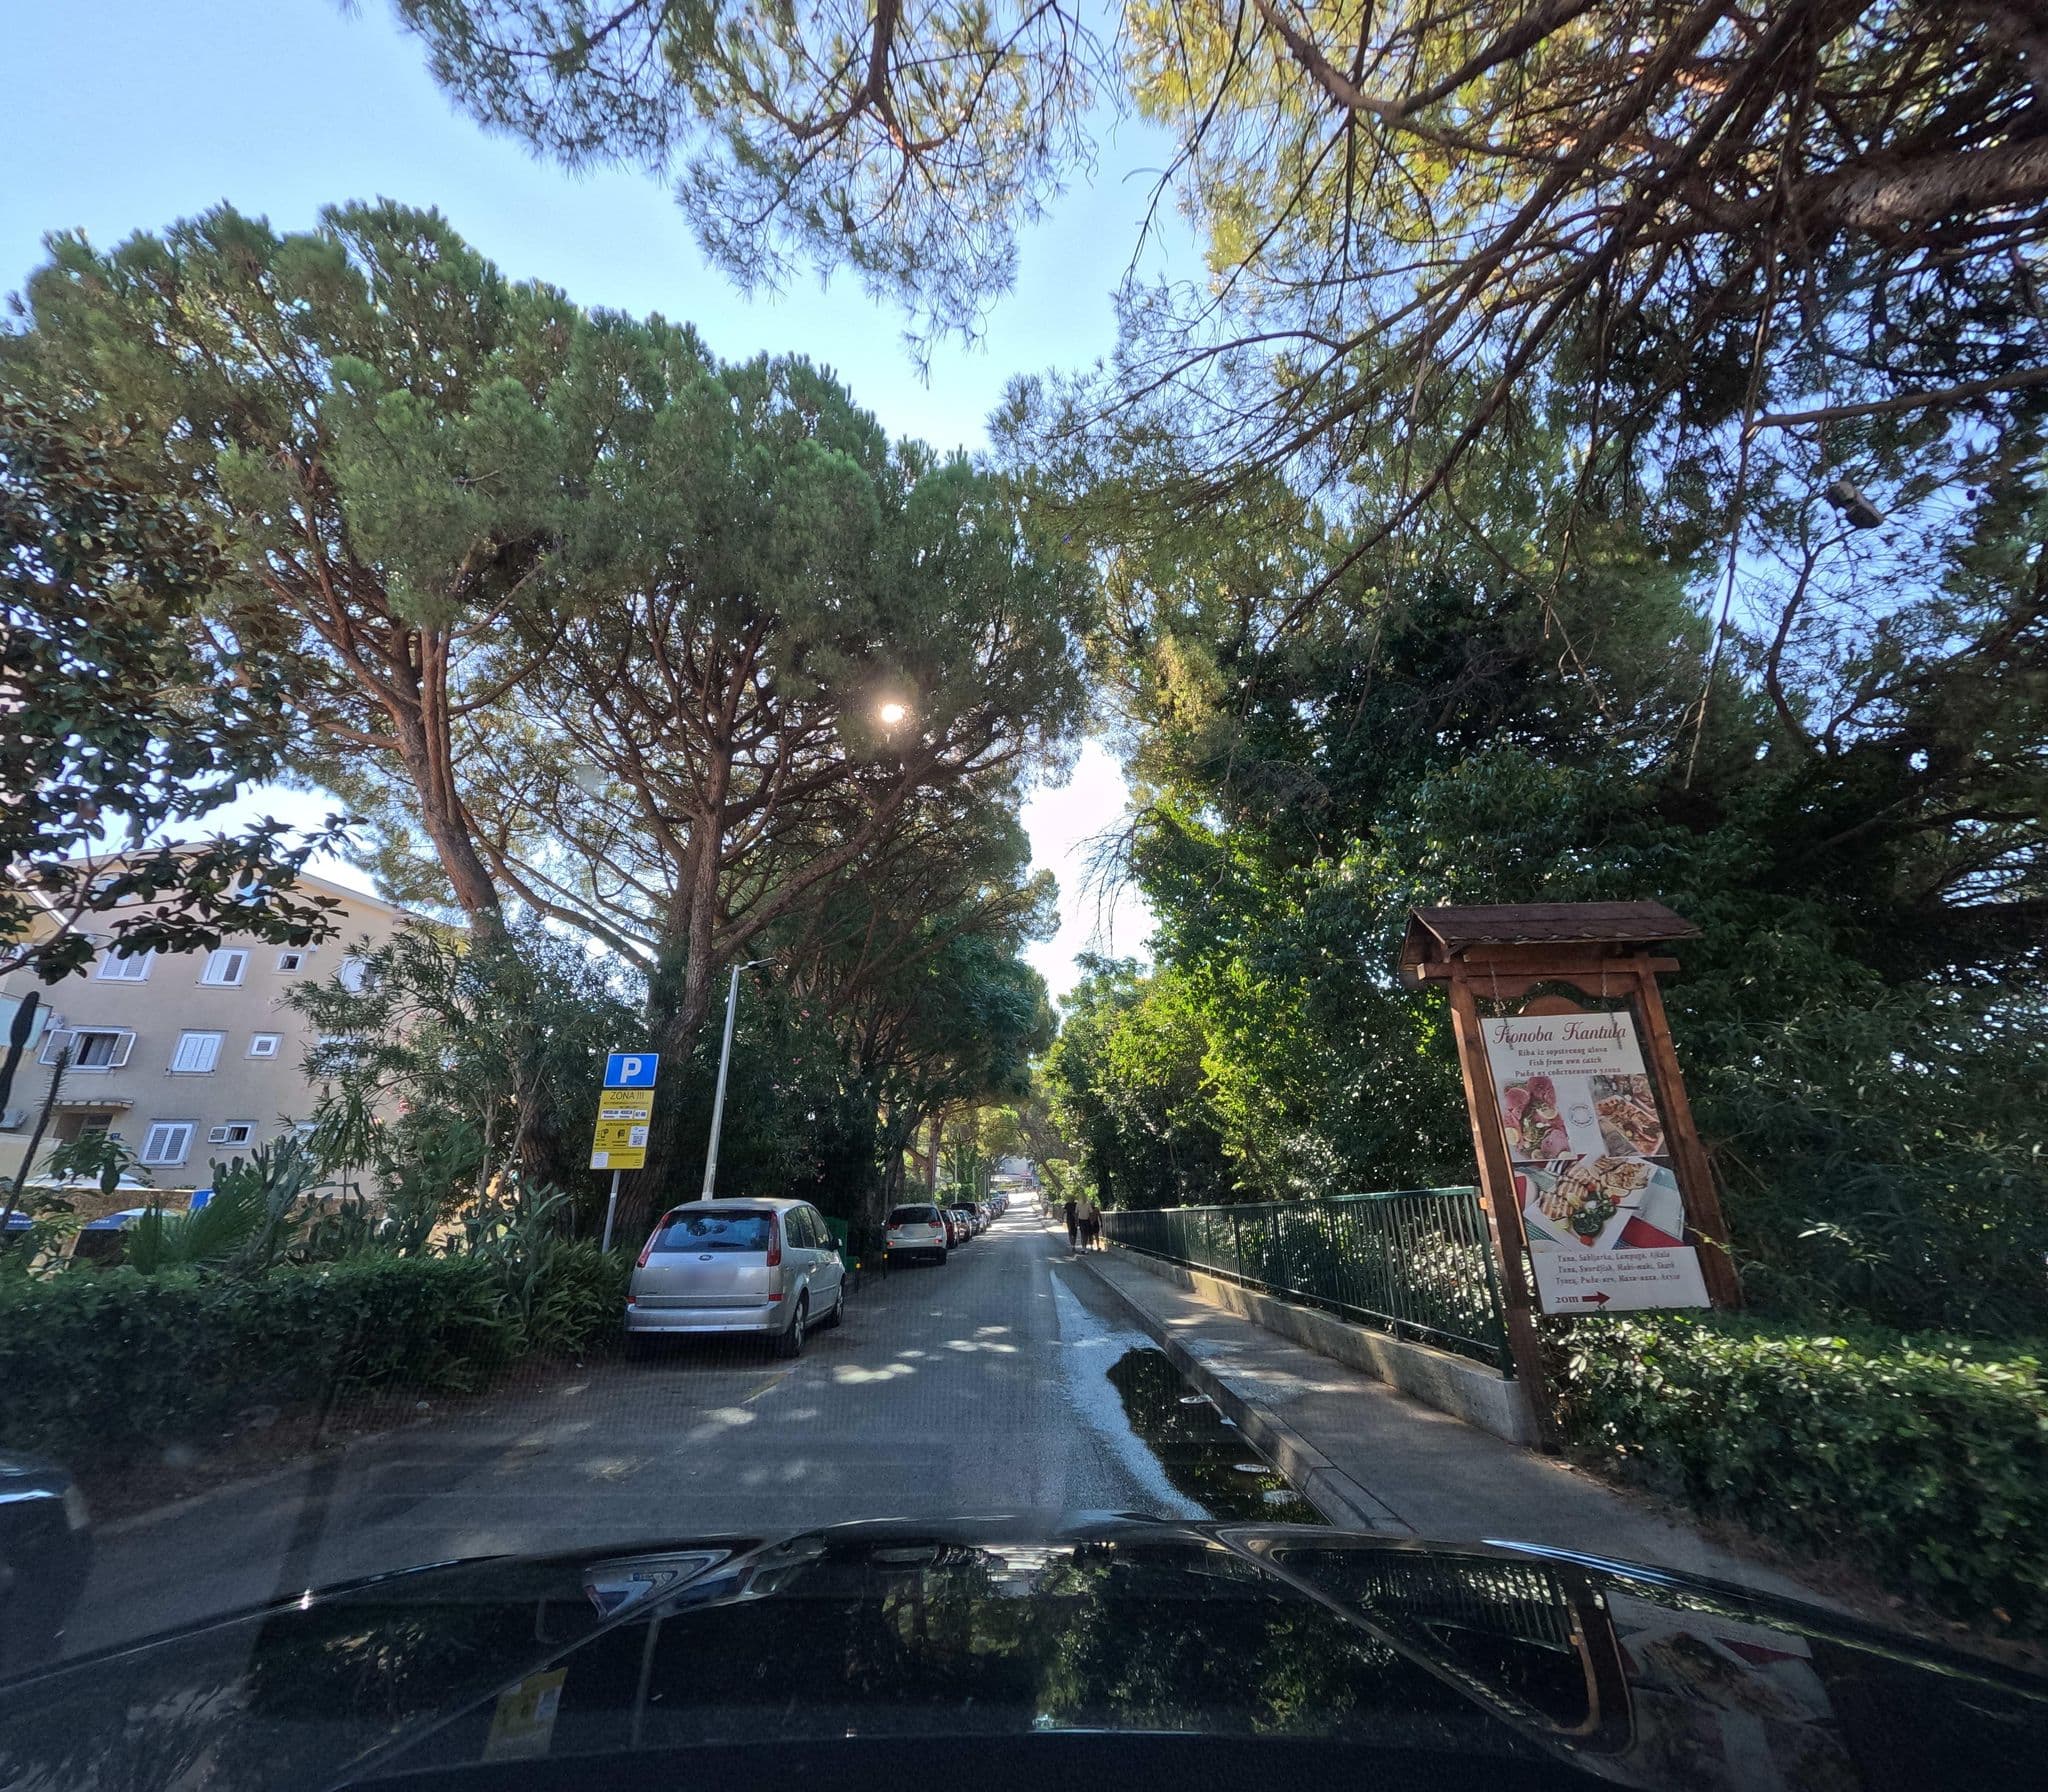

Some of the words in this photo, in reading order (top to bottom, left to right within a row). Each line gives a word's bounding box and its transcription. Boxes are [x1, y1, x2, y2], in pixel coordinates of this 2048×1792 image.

[1493, 1025, 1553, 1044] Konoba
[1562, 1021, 1626, 1041] Kantula
[1518, 1048, 1535, 1056] Riba
[1537, 1048, 1544, 1056] iz
[1529, 1058, 1544, 1066] Fish
[1546, 1058, 1564, 1067] from
[1583, 1056, 1602, 1064] catch
[610, 1091, 635, 1100] ZONA
[1555, 1295, 1579, 1304] 20m
